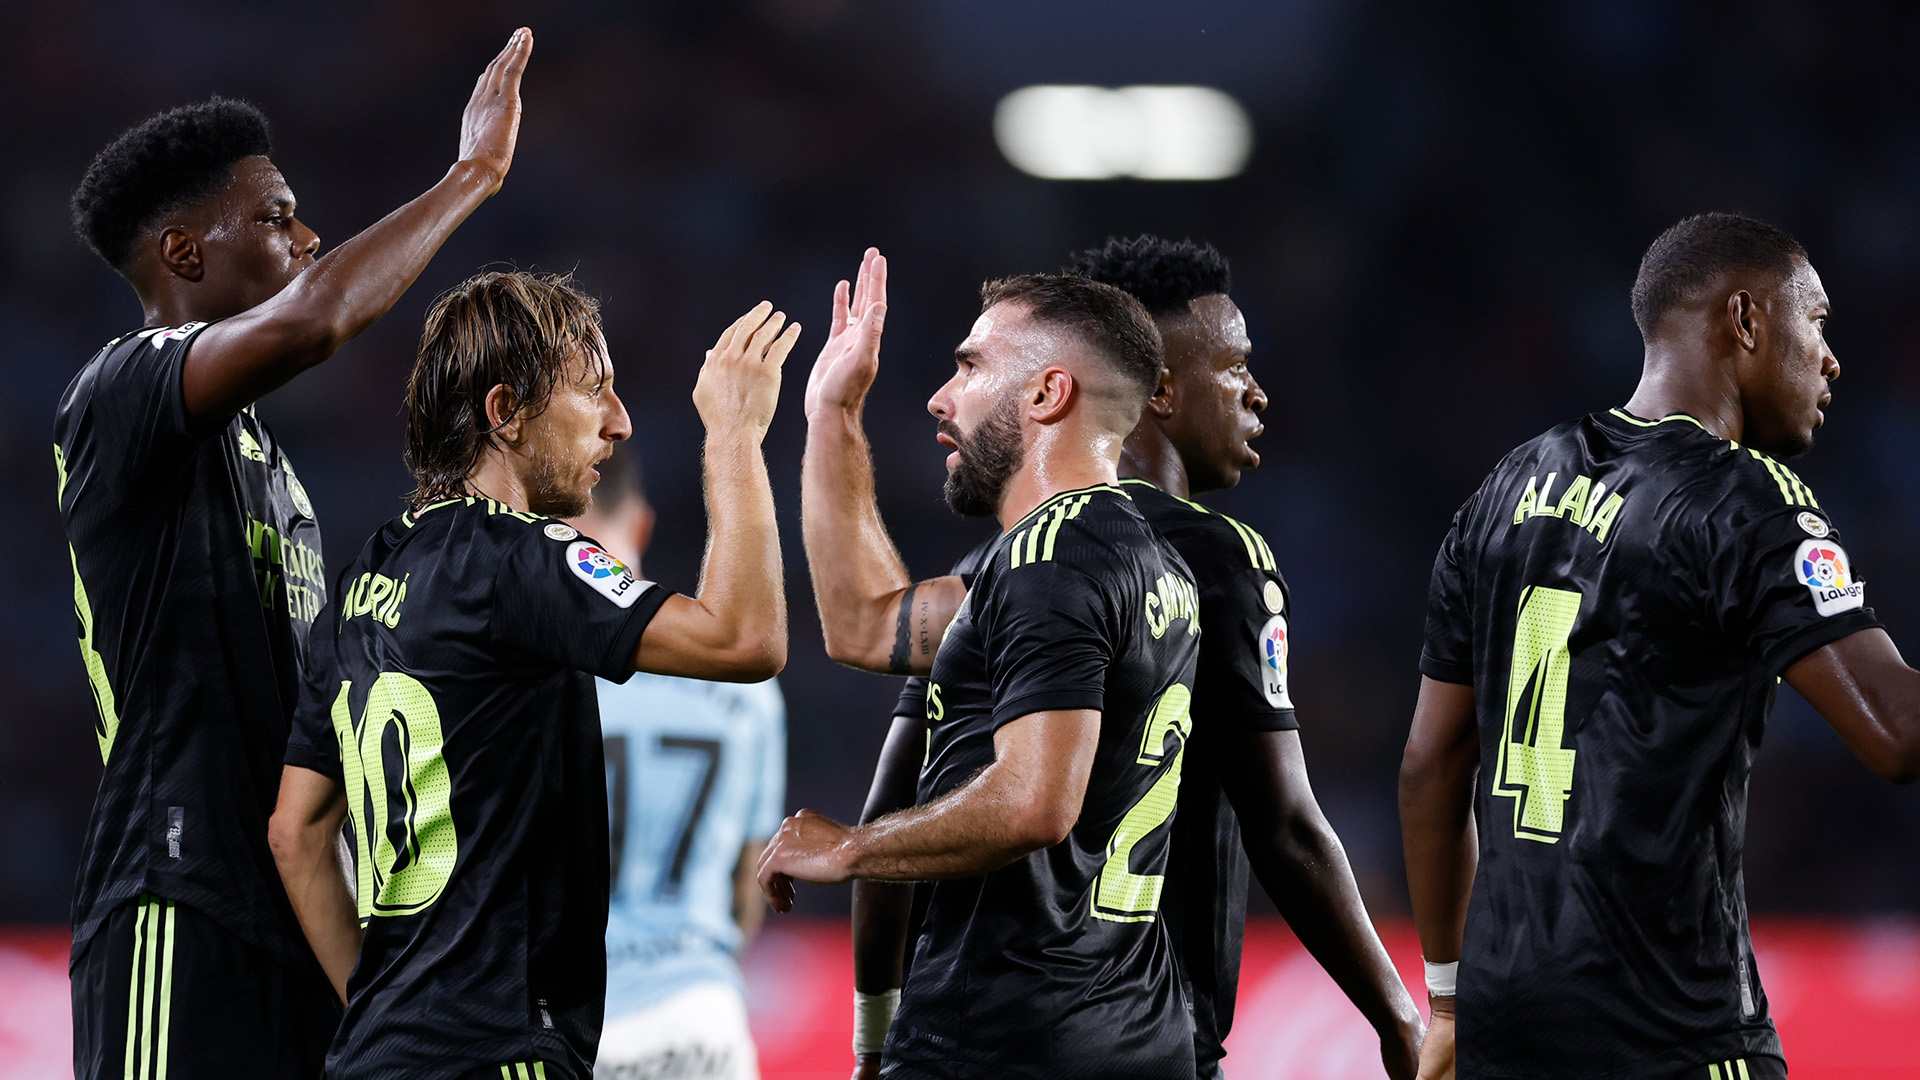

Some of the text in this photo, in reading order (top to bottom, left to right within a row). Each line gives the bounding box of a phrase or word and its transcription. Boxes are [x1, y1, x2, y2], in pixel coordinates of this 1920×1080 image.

[1513, 471, 1625, 544] ALABA
[331, 671, 458, 929] 10
[1090, 683, 1193, 923] 2
[1492, 585, 1582, 843] 4
